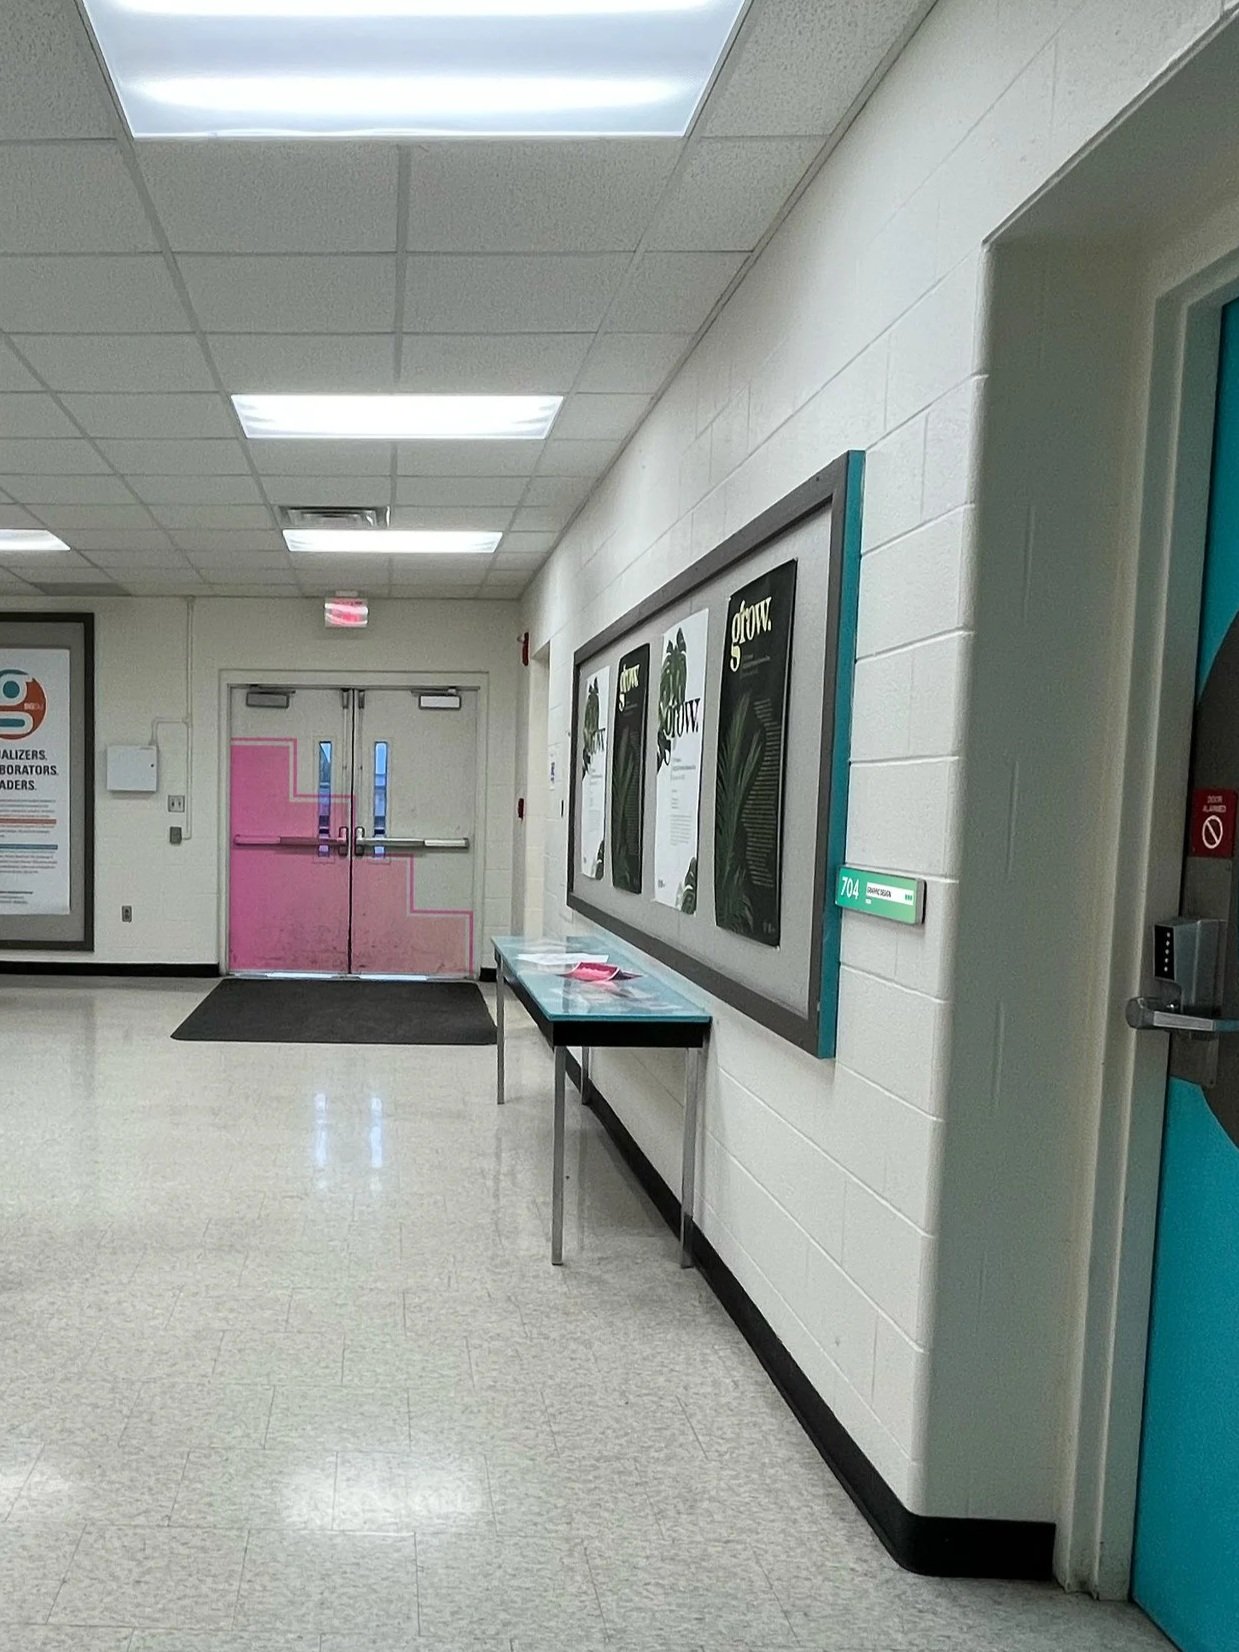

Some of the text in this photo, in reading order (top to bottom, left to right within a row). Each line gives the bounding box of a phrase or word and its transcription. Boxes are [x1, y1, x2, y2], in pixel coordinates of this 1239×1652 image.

[730, 596, 772, 672] grow.
[0, 749, 48, 761] ALIZERS.
[840, 876, 860, 900] 704
